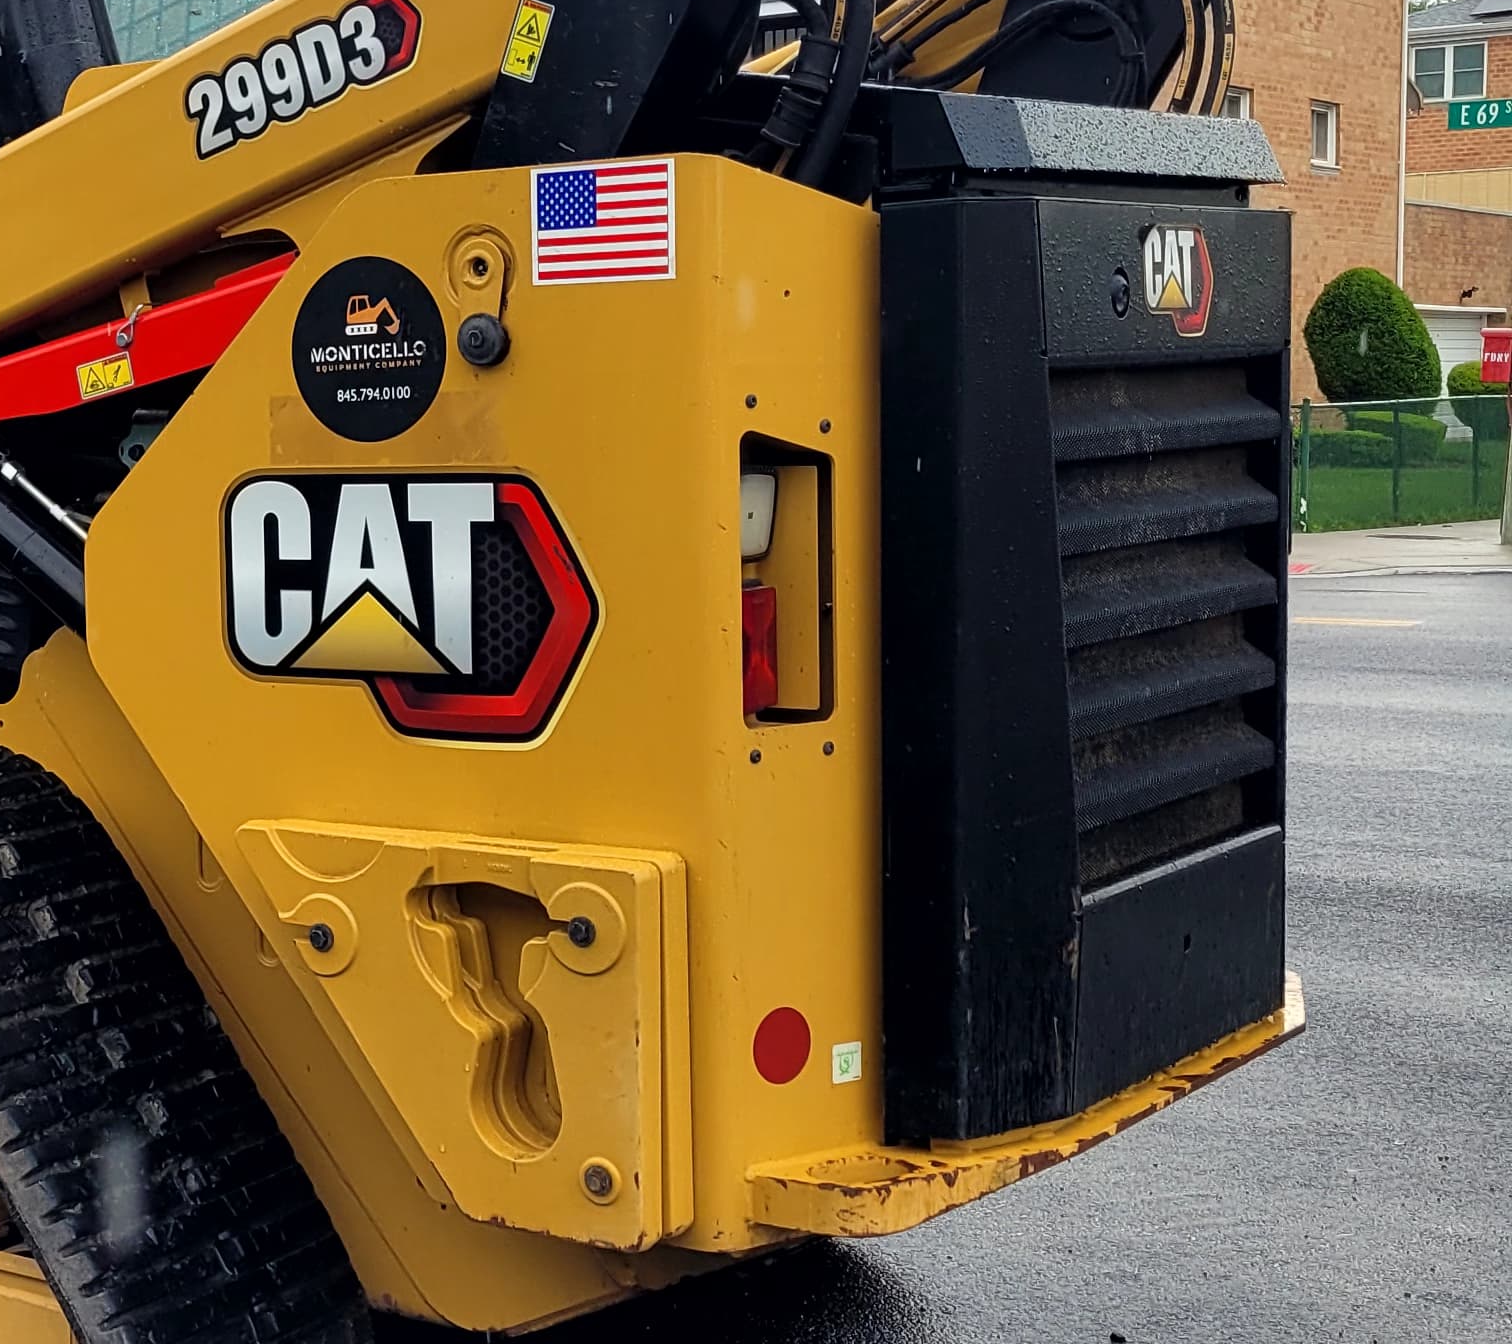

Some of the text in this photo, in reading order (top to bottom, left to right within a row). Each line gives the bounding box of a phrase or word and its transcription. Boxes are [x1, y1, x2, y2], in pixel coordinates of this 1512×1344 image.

[188, 5, 386, 155] 299D3
[1460, 100, 1512, 126] E 69 S
[1144, 228, 1195, 309] CAT
[310, 340, 427, 364] MONTICELLO
[1483, 352, 1510, 363] FDNY
[315, 358, 423, 374] EQUIPMENT COMPANY
[336, 385, 411, 403] 845.794.0100
[231, 480, 495, 675] CAT
